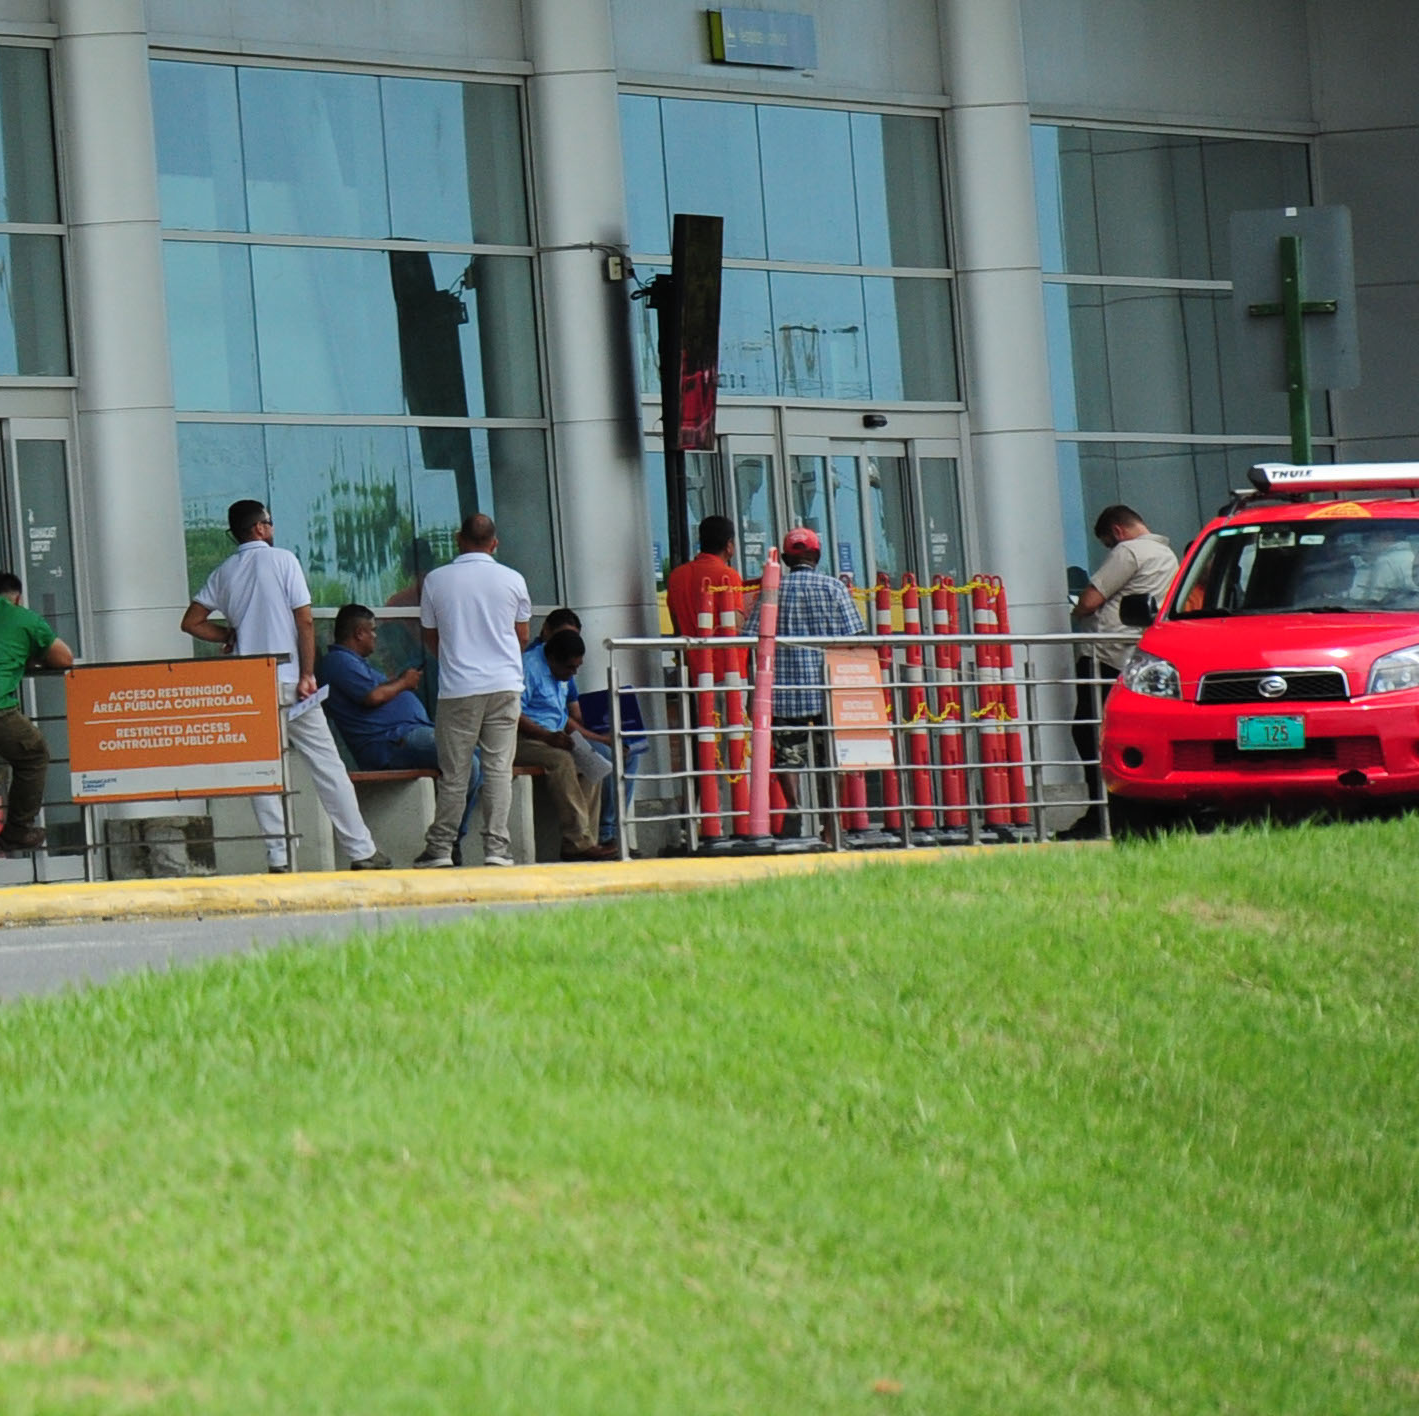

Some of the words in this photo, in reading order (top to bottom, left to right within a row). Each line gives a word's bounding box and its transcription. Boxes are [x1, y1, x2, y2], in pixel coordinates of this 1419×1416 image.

[108, 689, 156, 702] ACCESO
[157, 683, 234, 699] RESTRINGIDO
[92, 700, 123, 714] ÁREA
[124, 697, 173, 712] PÚBLICA
[174, 694, 254, 710] CONTROLADA
[116, 724, 184, 739] RESTRICTED
[185, 722, 232, 735] ACCESS
[1264, 724, 1290, 742] 125
[98, 737, 174, 752] CONTROLLED
[174, 733, 215, 747] PUBLIC
[216, 732, 248, 745] AREA
